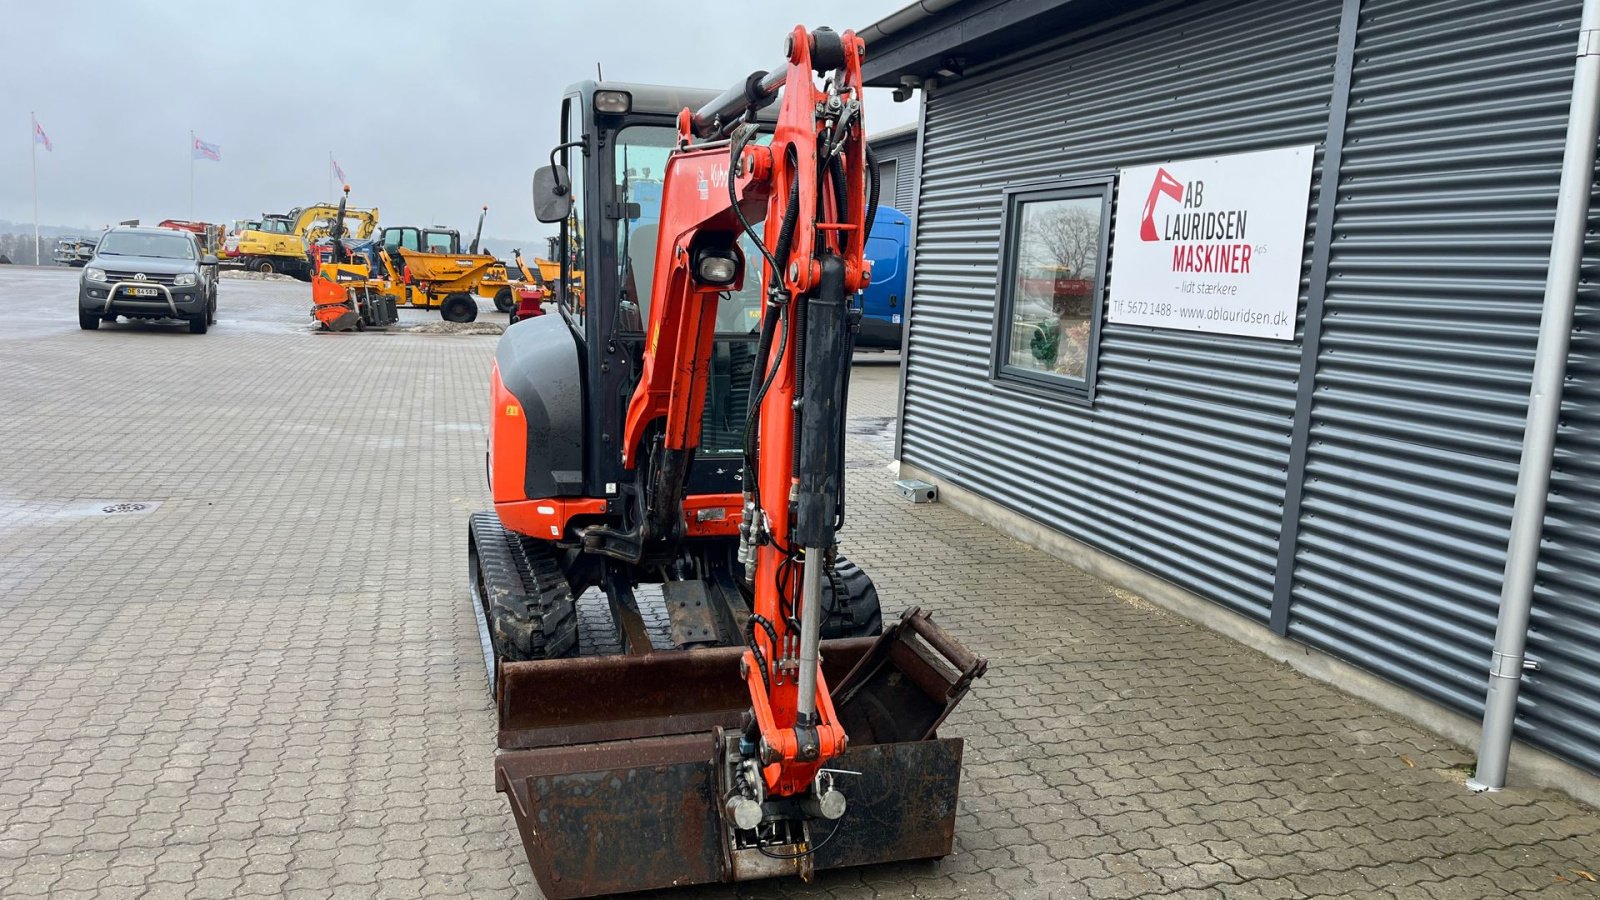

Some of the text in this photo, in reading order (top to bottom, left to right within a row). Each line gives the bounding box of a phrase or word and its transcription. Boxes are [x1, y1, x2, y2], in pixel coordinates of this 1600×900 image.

[1184, 180, 1204, 208] AB
[1165, 210, 1247, 240] LAURIDSEN
[1172, 243, 1268, 273] MASKINER ApS
[1181, 281, 1195, 294] lidt
[1197, 282, 1238, 296] stærkere
[1113, 300, 1126, 316] Tlf.
[1128, 301, 1148, 315] 5672
[1150, 302, 1172, 317] 1488
[1180, 307, 1288, 326] www.ablauridsen.dk
